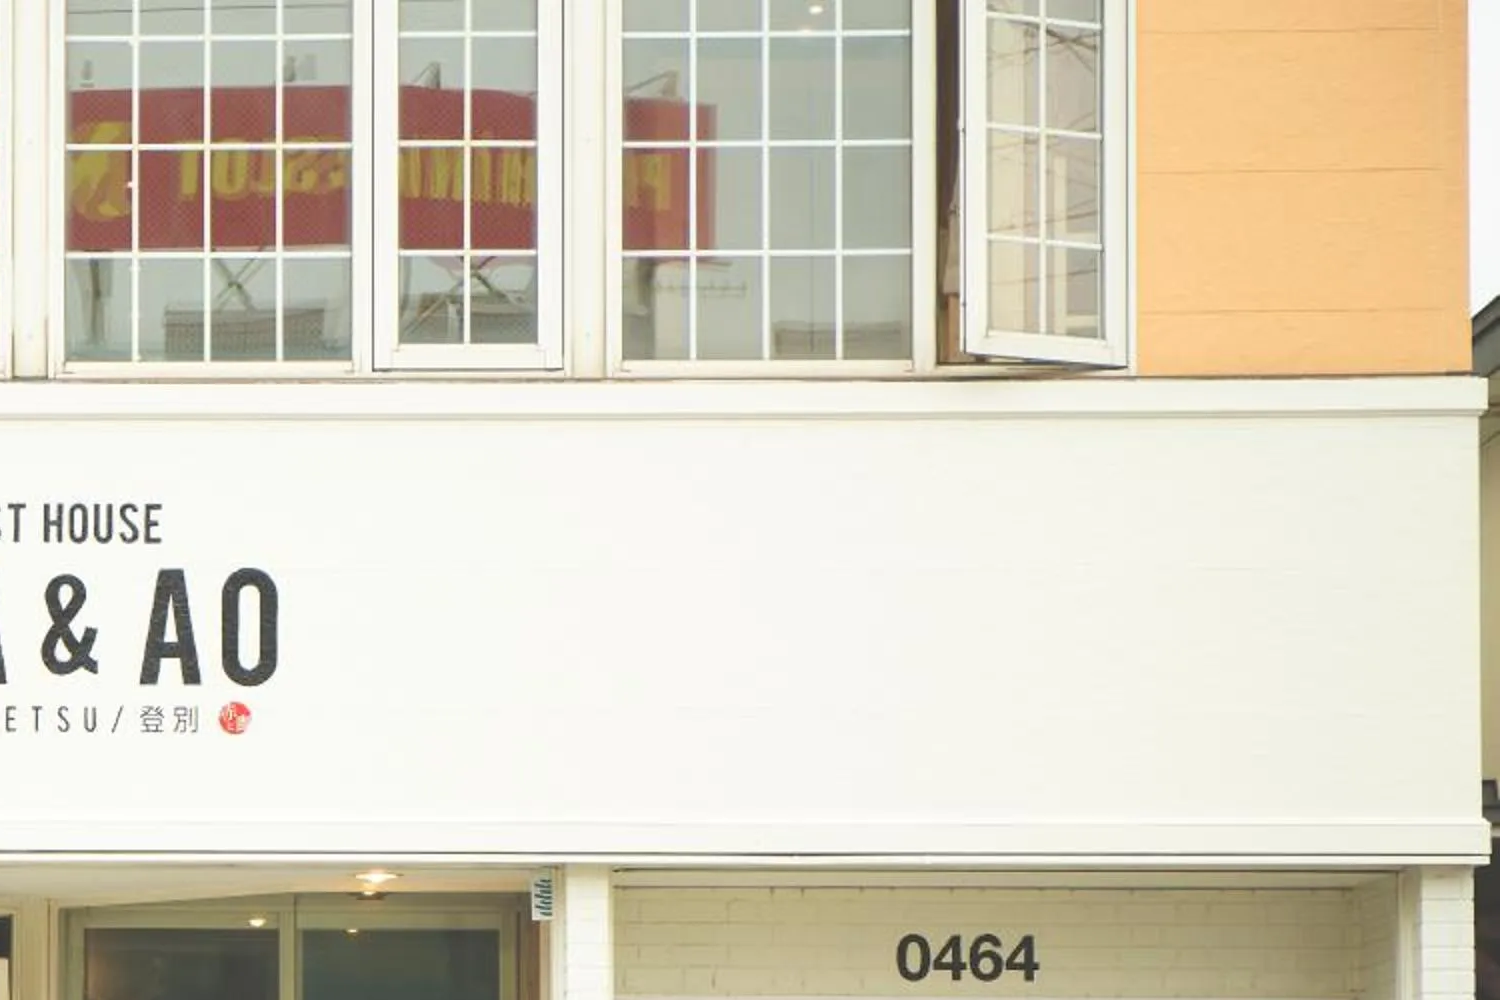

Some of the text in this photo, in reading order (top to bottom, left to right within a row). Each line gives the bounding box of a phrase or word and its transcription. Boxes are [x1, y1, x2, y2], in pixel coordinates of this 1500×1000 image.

[43, 502, 163, 545] HOUSE
[40, 573, 99, 676] &
[139, 567, 279, 687] AO
[139, 705, 200, 734] 登別
[896, 933, 1040, 982] 0464
